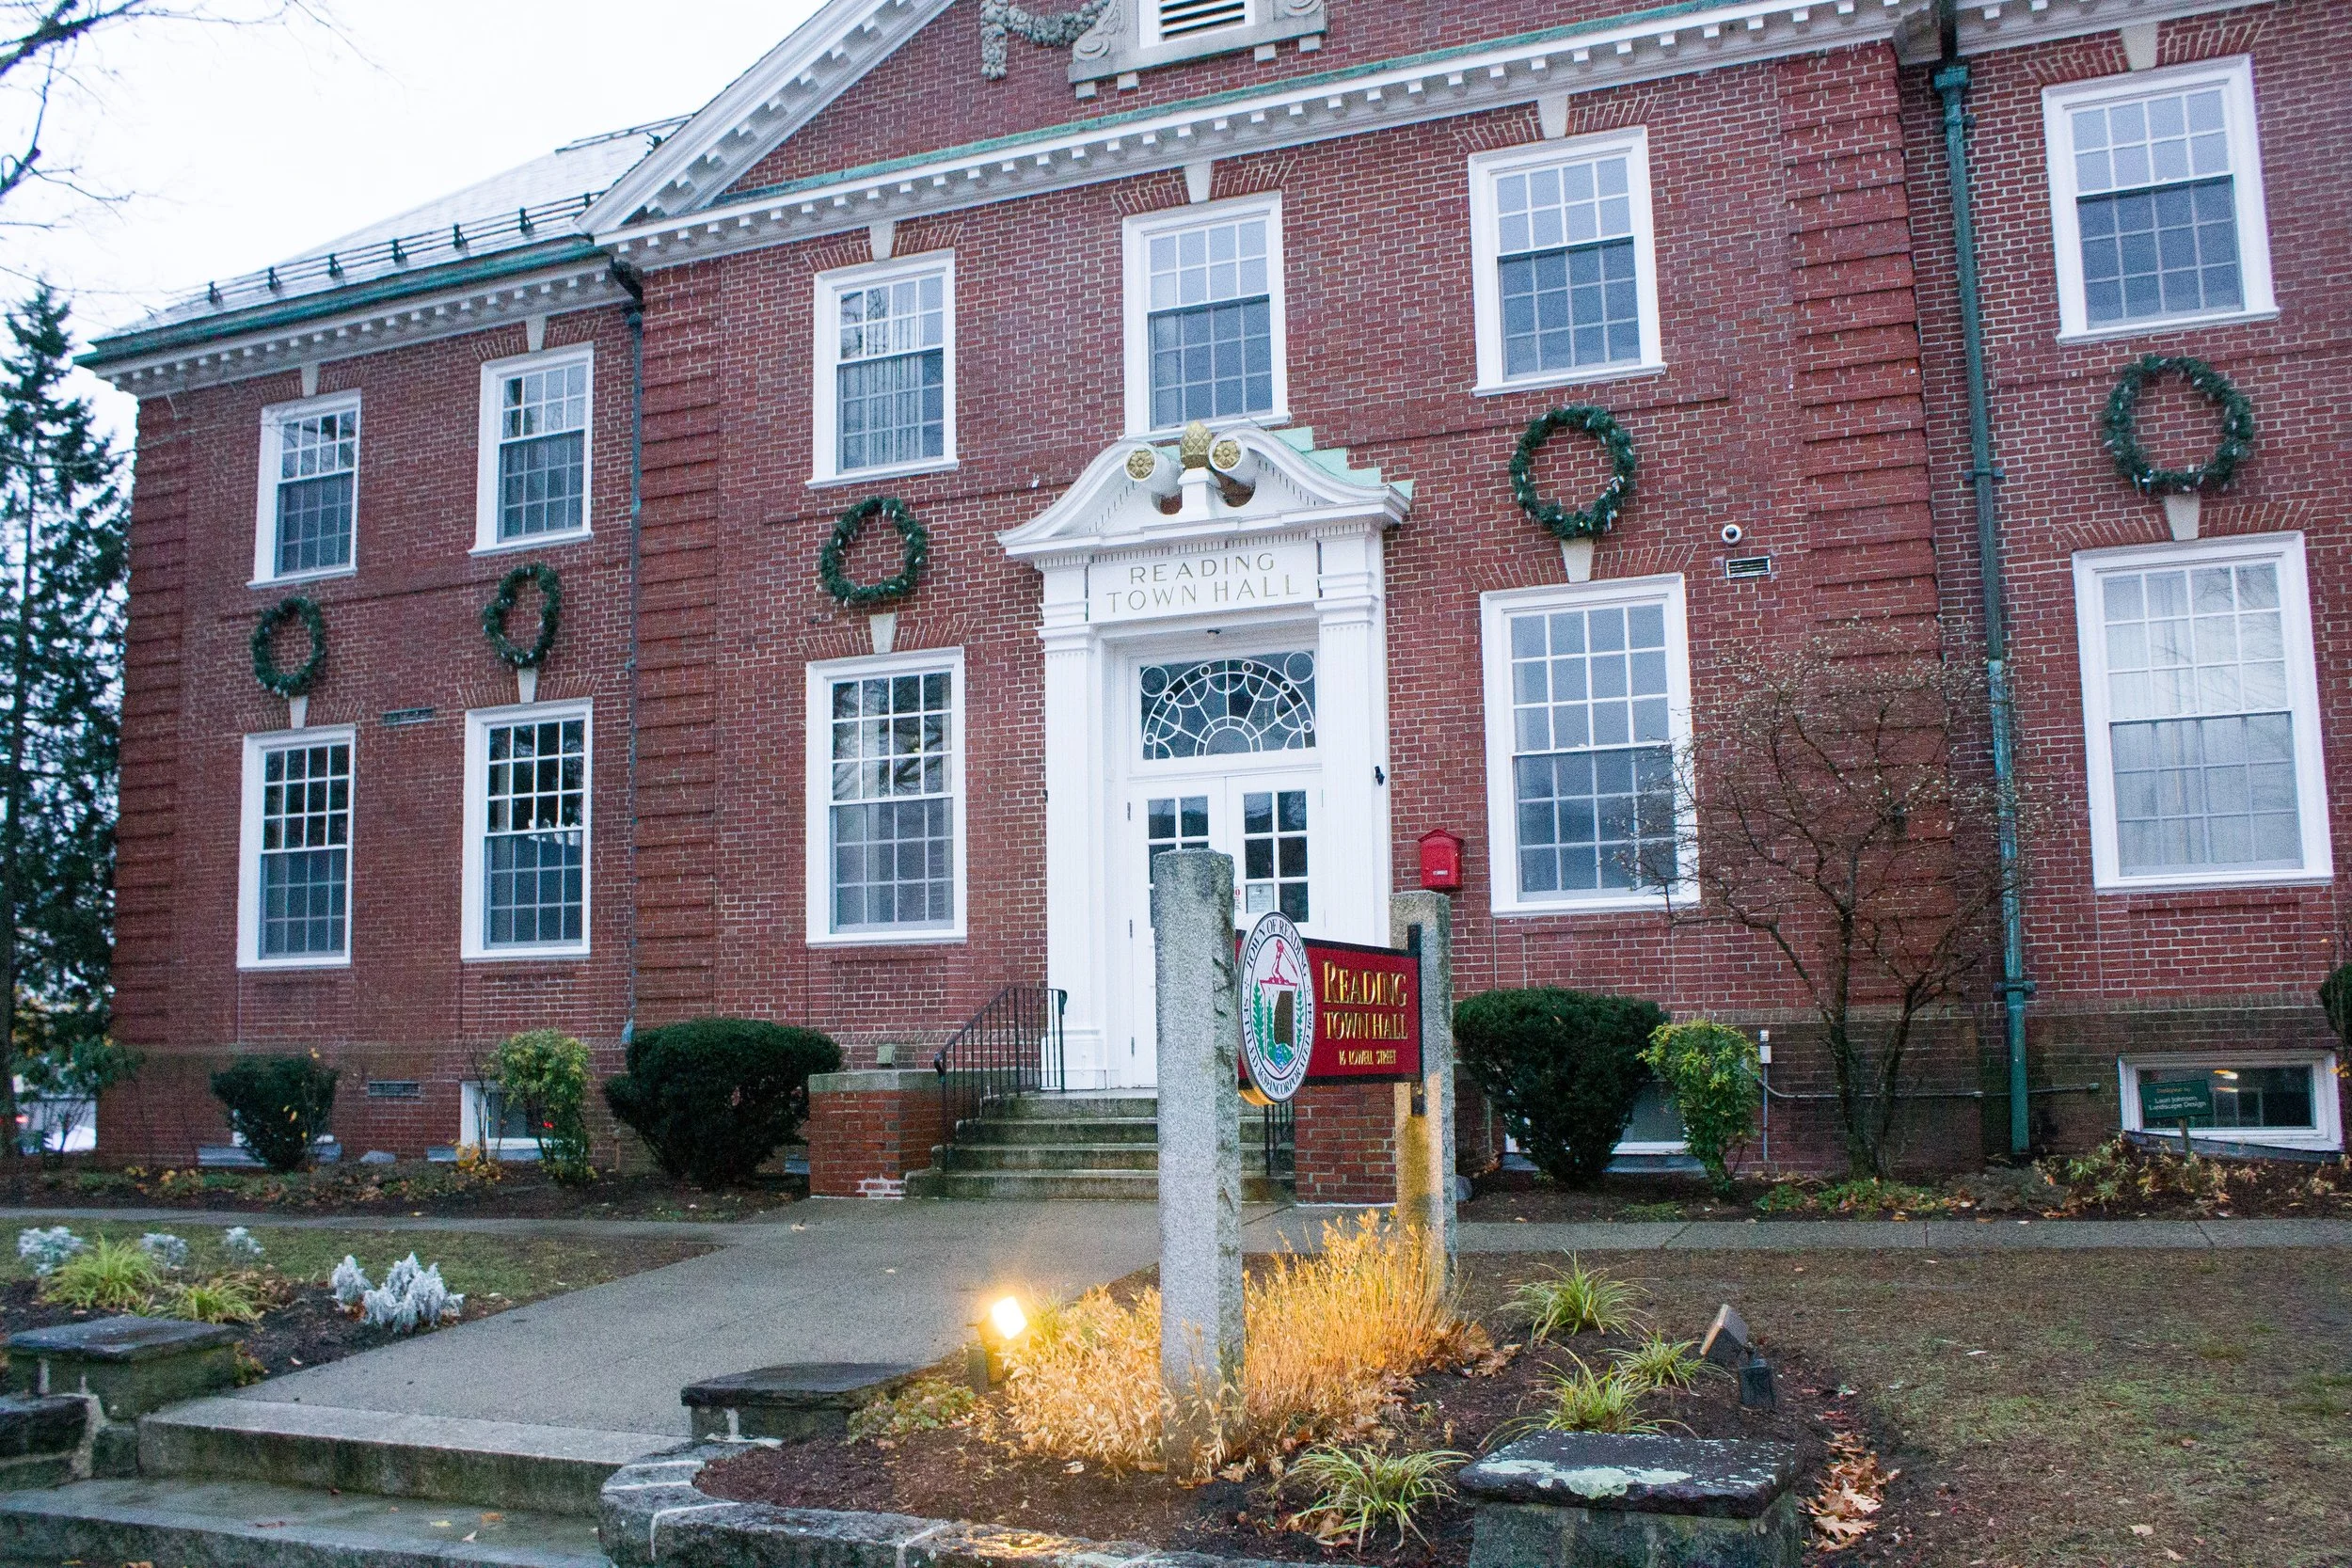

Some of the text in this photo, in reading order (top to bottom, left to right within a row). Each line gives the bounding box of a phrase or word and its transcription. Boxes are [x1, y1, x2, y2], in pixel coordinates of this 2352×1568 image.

[1130, 552, 1275, 585] READING
[1105, 574, 1301, 613] TOWN HALL
[1246, 918, 1309, 977] TOWN OF READING
[1322, 959, 1407, 1007] READING
[1323, 1010, 1409, 1040] TOWN HALL
[1269, 1034, 1311, 1095] INCORPORATED
[1339, 1049, 1397, 1066] 16 LOWELL STREET
[2148, 1102, 2183, 1111] Landscape
